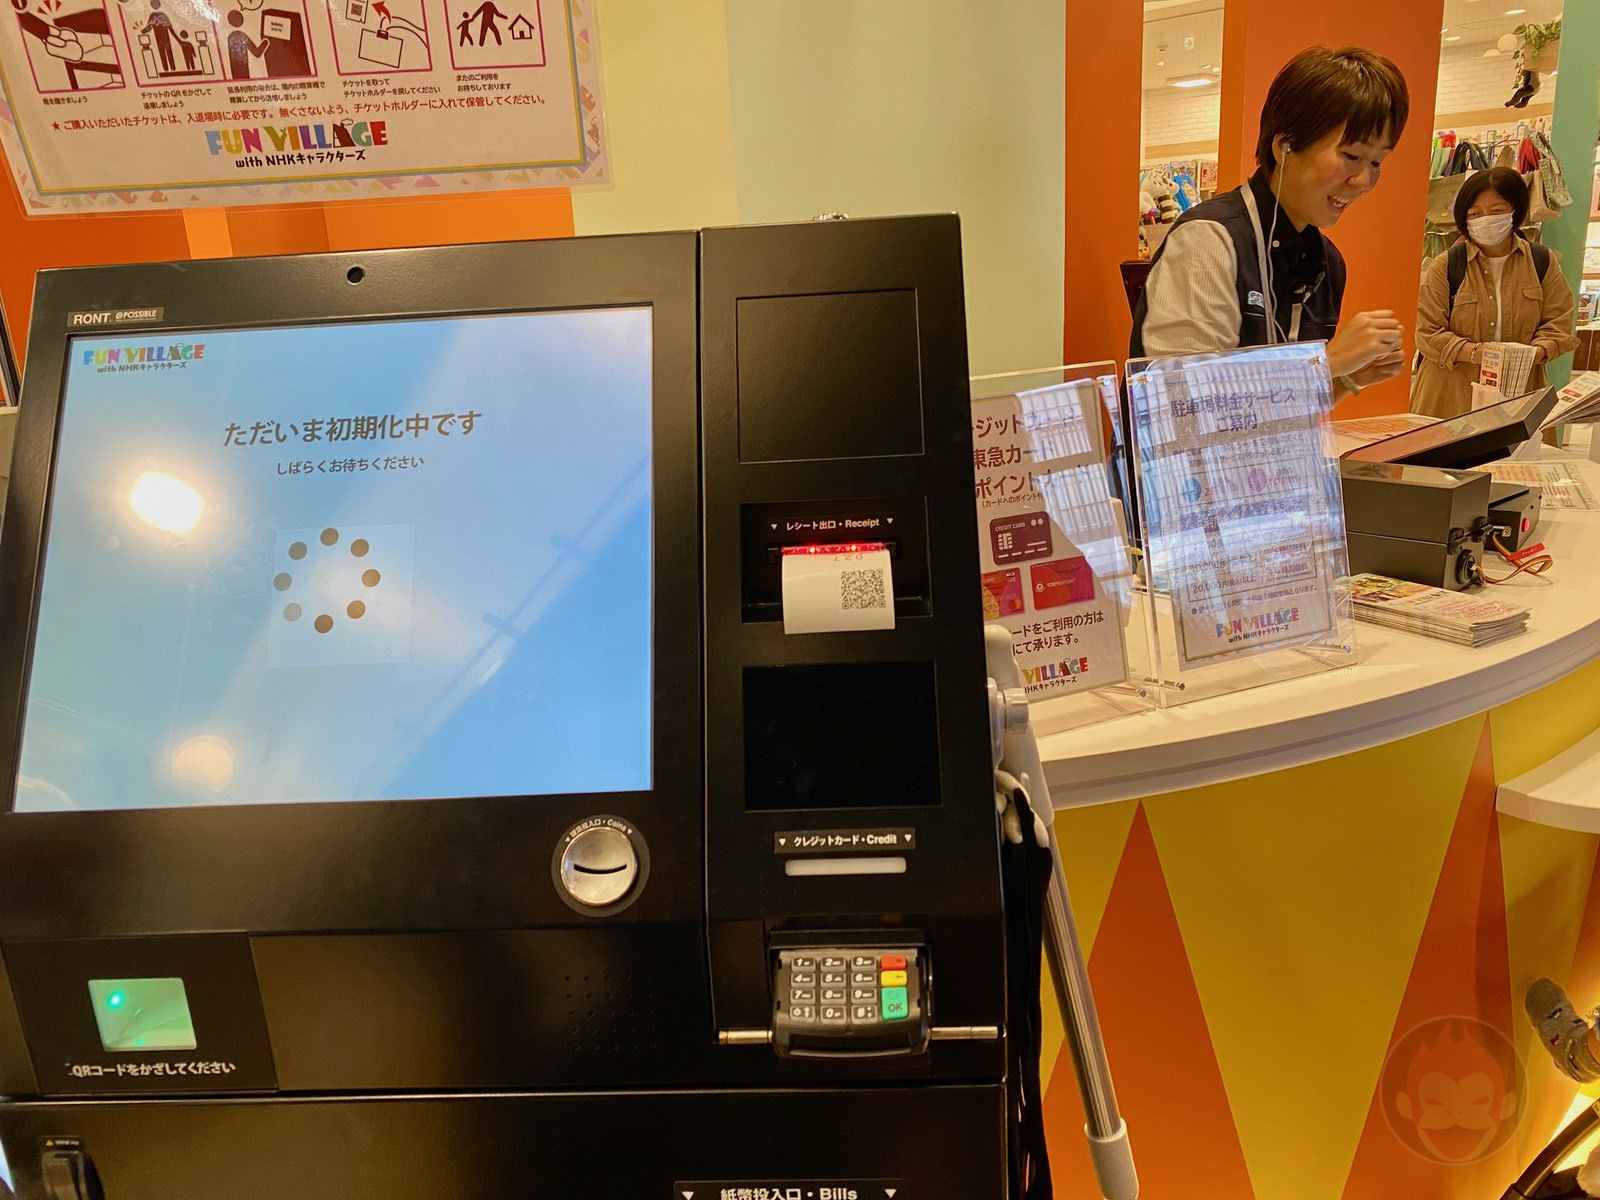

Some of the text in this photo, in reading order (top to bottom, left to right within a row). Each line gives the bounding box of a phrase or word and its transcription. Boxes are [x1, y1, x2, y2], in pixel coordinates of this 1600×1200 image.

[456, 73, 499, 83] またのご利用を
[457, 83, 511, 93] お待ちしております
[205, 119, 388, 155] FUN VILLAGE
[235, 149, 366, 168] with NHKキャラクターズ
[73, 312, 111, 325] RONT
[83, 343, 205, 365] FUN VILLAGE
[97, 361, 188, 373] with NHKキャラクターズ
[223, 410, 482, 447] ただいま初期化中です
[1217, 414, 1258, 433] ご案内
[276, 456, 425, 475] しばらくお待ちください
[1009, 610, 1105, 638] ードをご利用の方は
[1215, 607, 1299, 638] FUN VILLAGE
[1012, 632, 1079, 656] にて承ります。
[1021, 657, 1089, 685] VILLAGE
[888, 1002, 903, 1013] OK
[71, 1061, 236, 1077] QRコードをかざしてください
